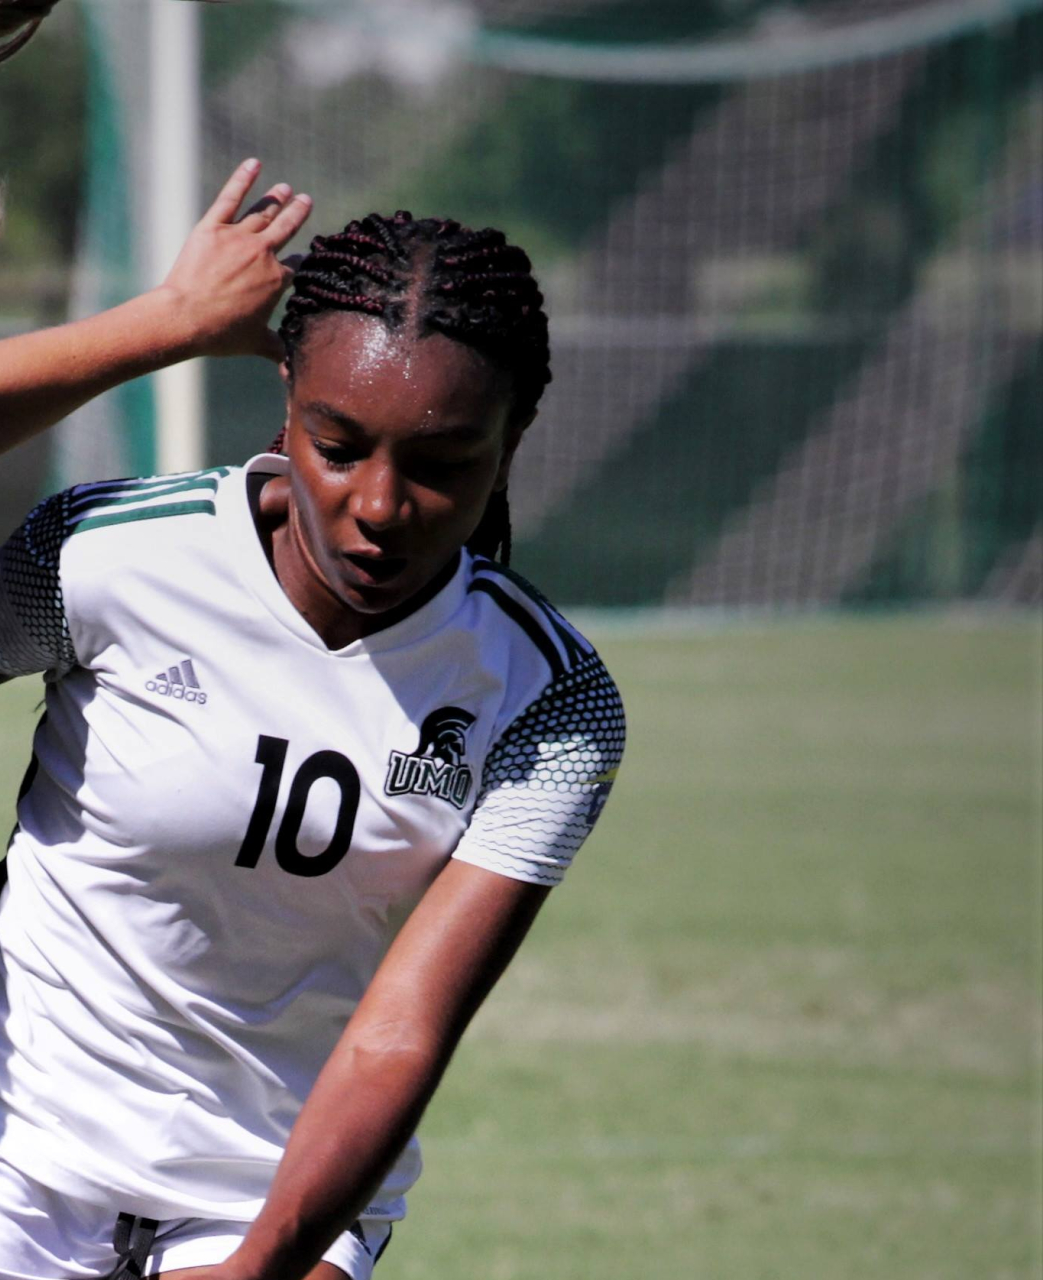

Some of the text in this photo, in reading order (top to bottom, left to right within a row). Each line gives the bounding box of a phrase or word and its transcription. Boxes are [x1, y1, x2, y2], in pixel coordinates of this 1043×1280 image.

[145, 680, 208, 705] adidas
[235, 734, 361, 878] 10
[384, 749, 473, 810] UMO
